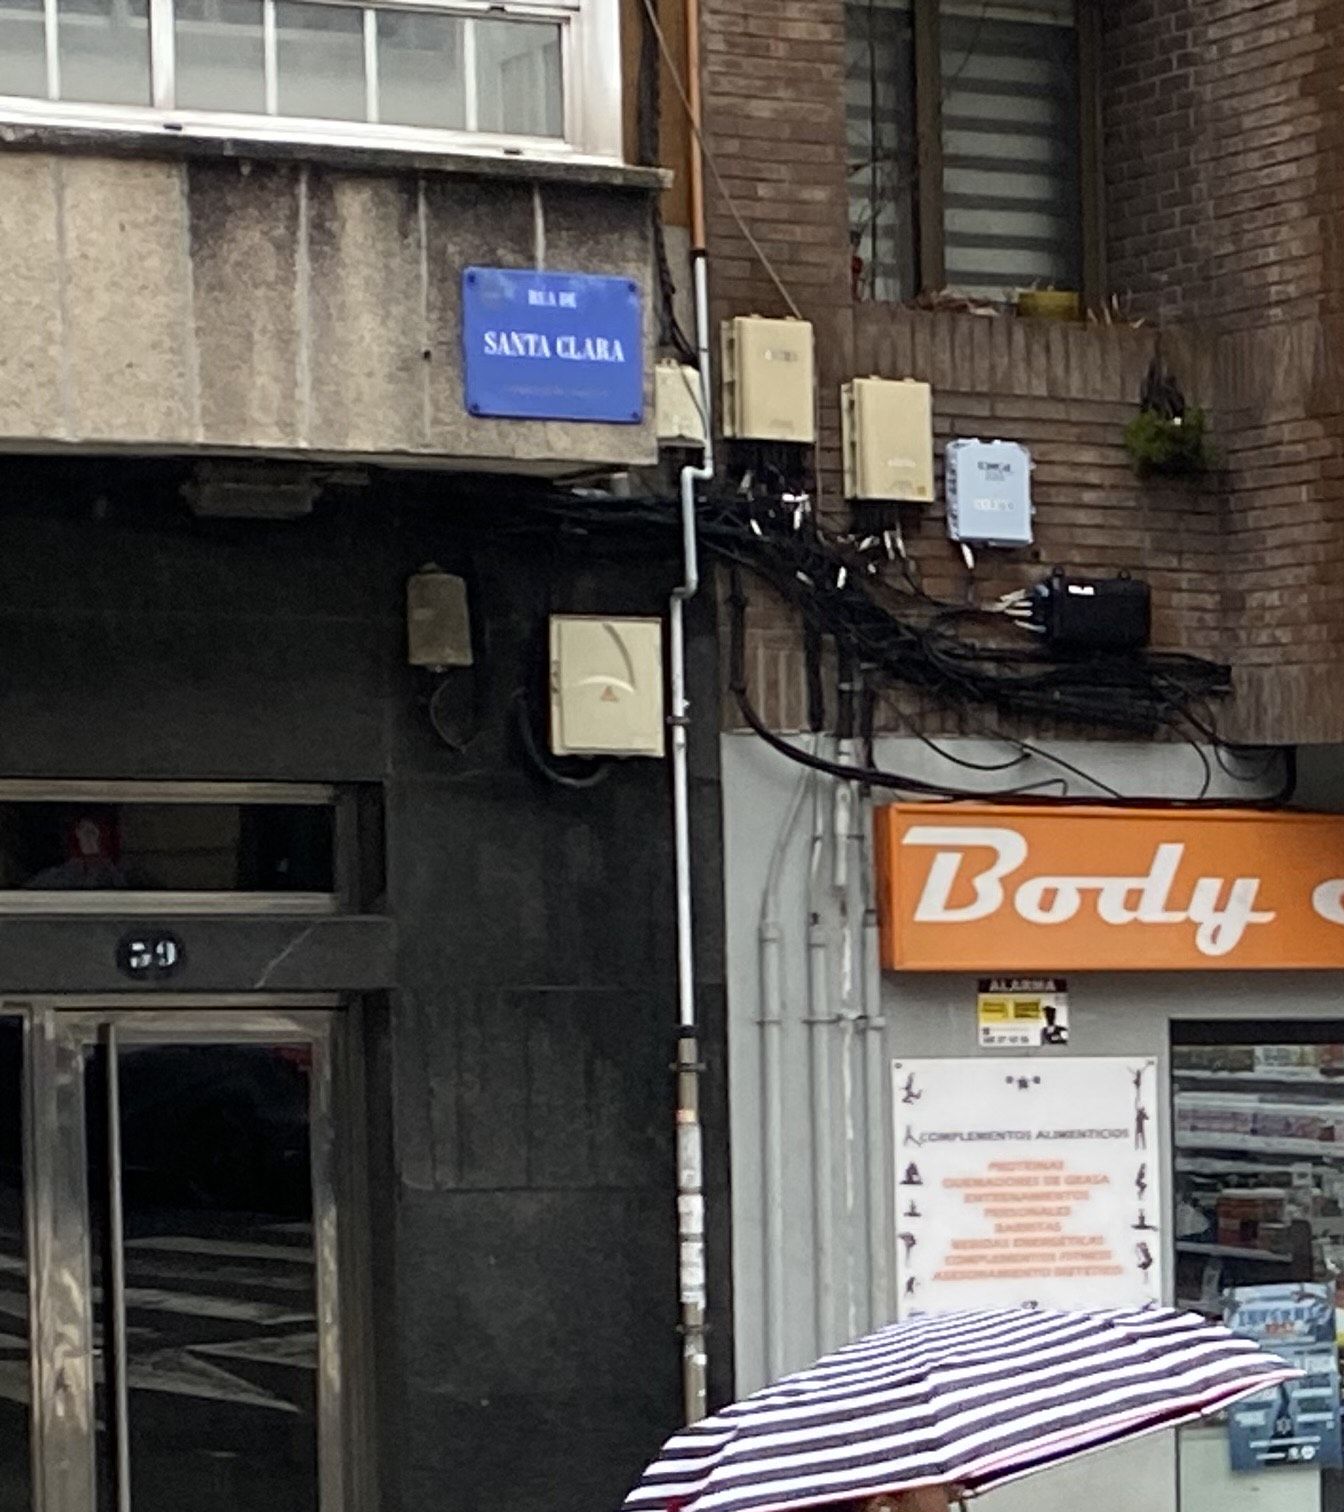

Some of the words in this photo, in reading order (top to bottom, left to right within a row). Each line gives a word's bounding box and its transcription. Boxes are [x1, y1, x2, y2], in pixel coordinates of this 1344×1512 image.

[484, 330, 551, 358] SANTA
[556, 335, 626, 363] CLARA
[901, 825, 1277, 956] Body
[989, 978, 1056, 993] ALARMA
[919, 1129, 1031, 1144] COMPLEMENTOS
[1035, 1128, 1129, 1141] ALIMENTICIOS
